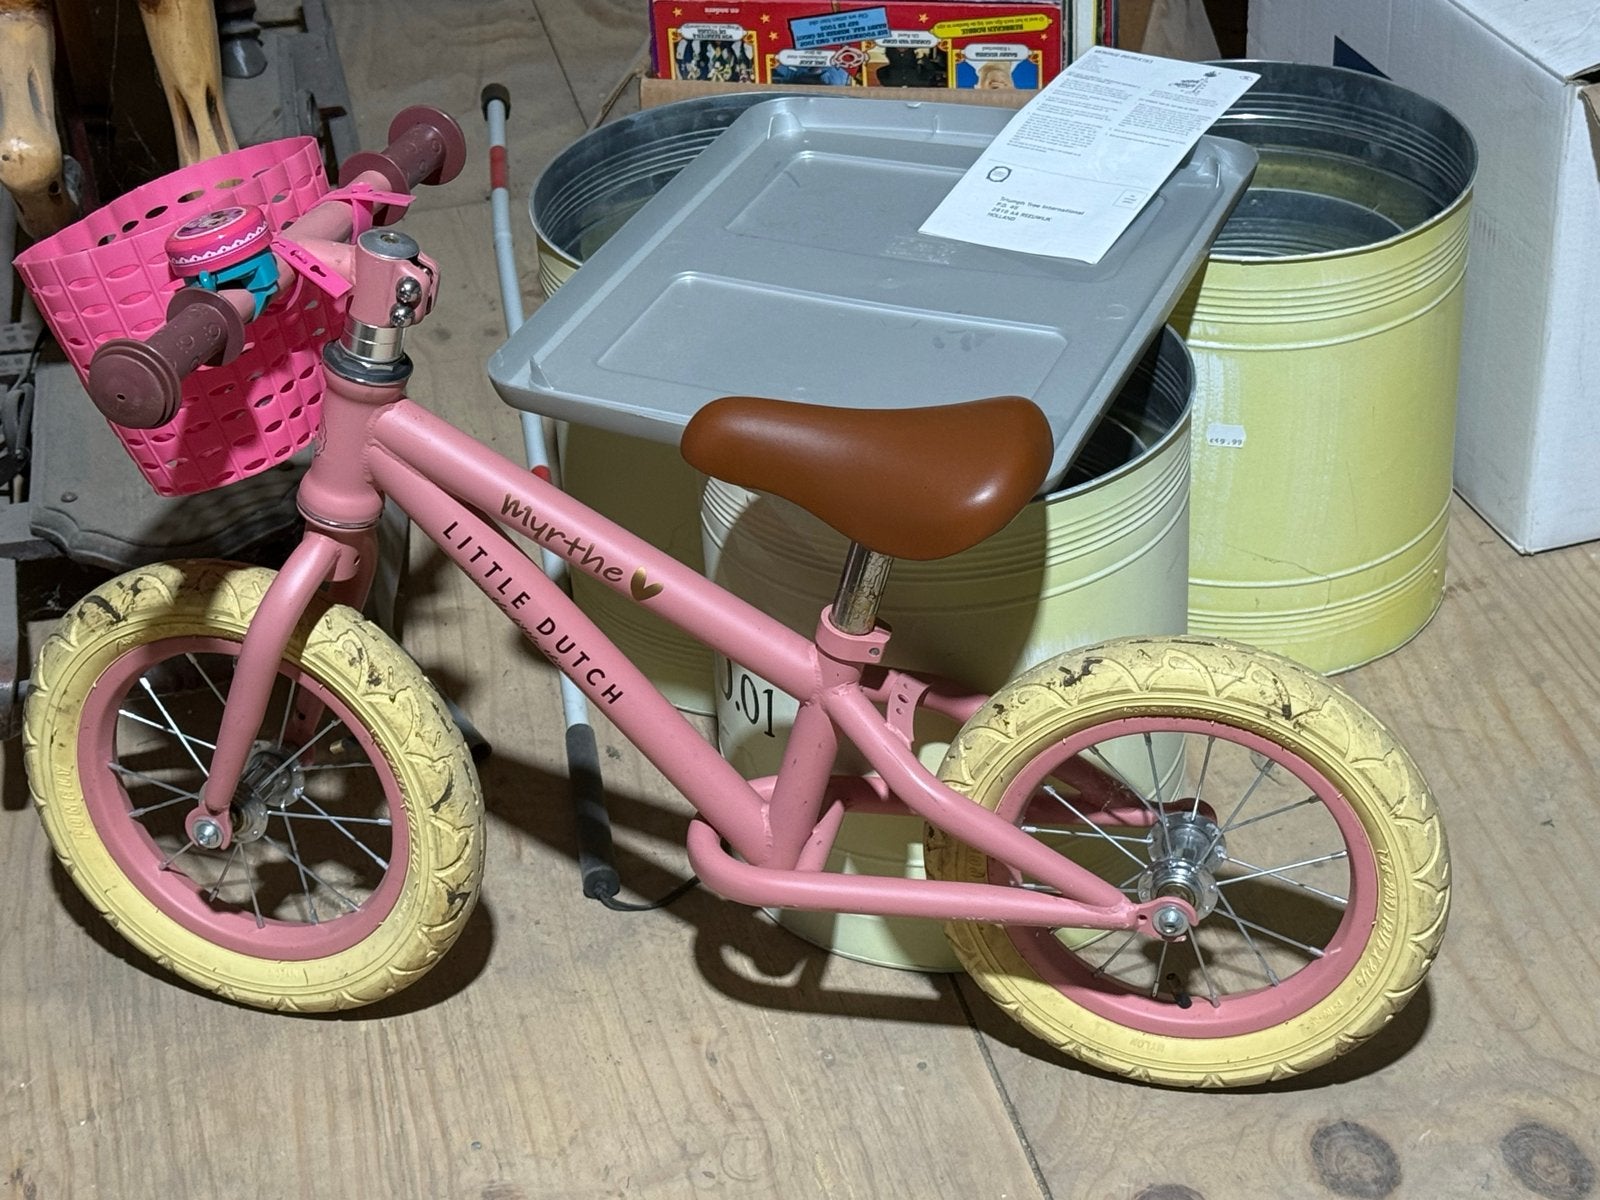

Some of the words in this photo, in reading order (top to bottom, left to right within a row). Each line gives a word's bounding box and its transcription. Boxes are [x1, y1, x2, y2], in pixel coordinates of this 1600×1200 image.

[1042, 204, 1085, 215] International
[987, 212, 1016, 221] HOLLAND
[443, 521, 531, 610] LITTLE
[536, 616, 624, 704] DUTCH
